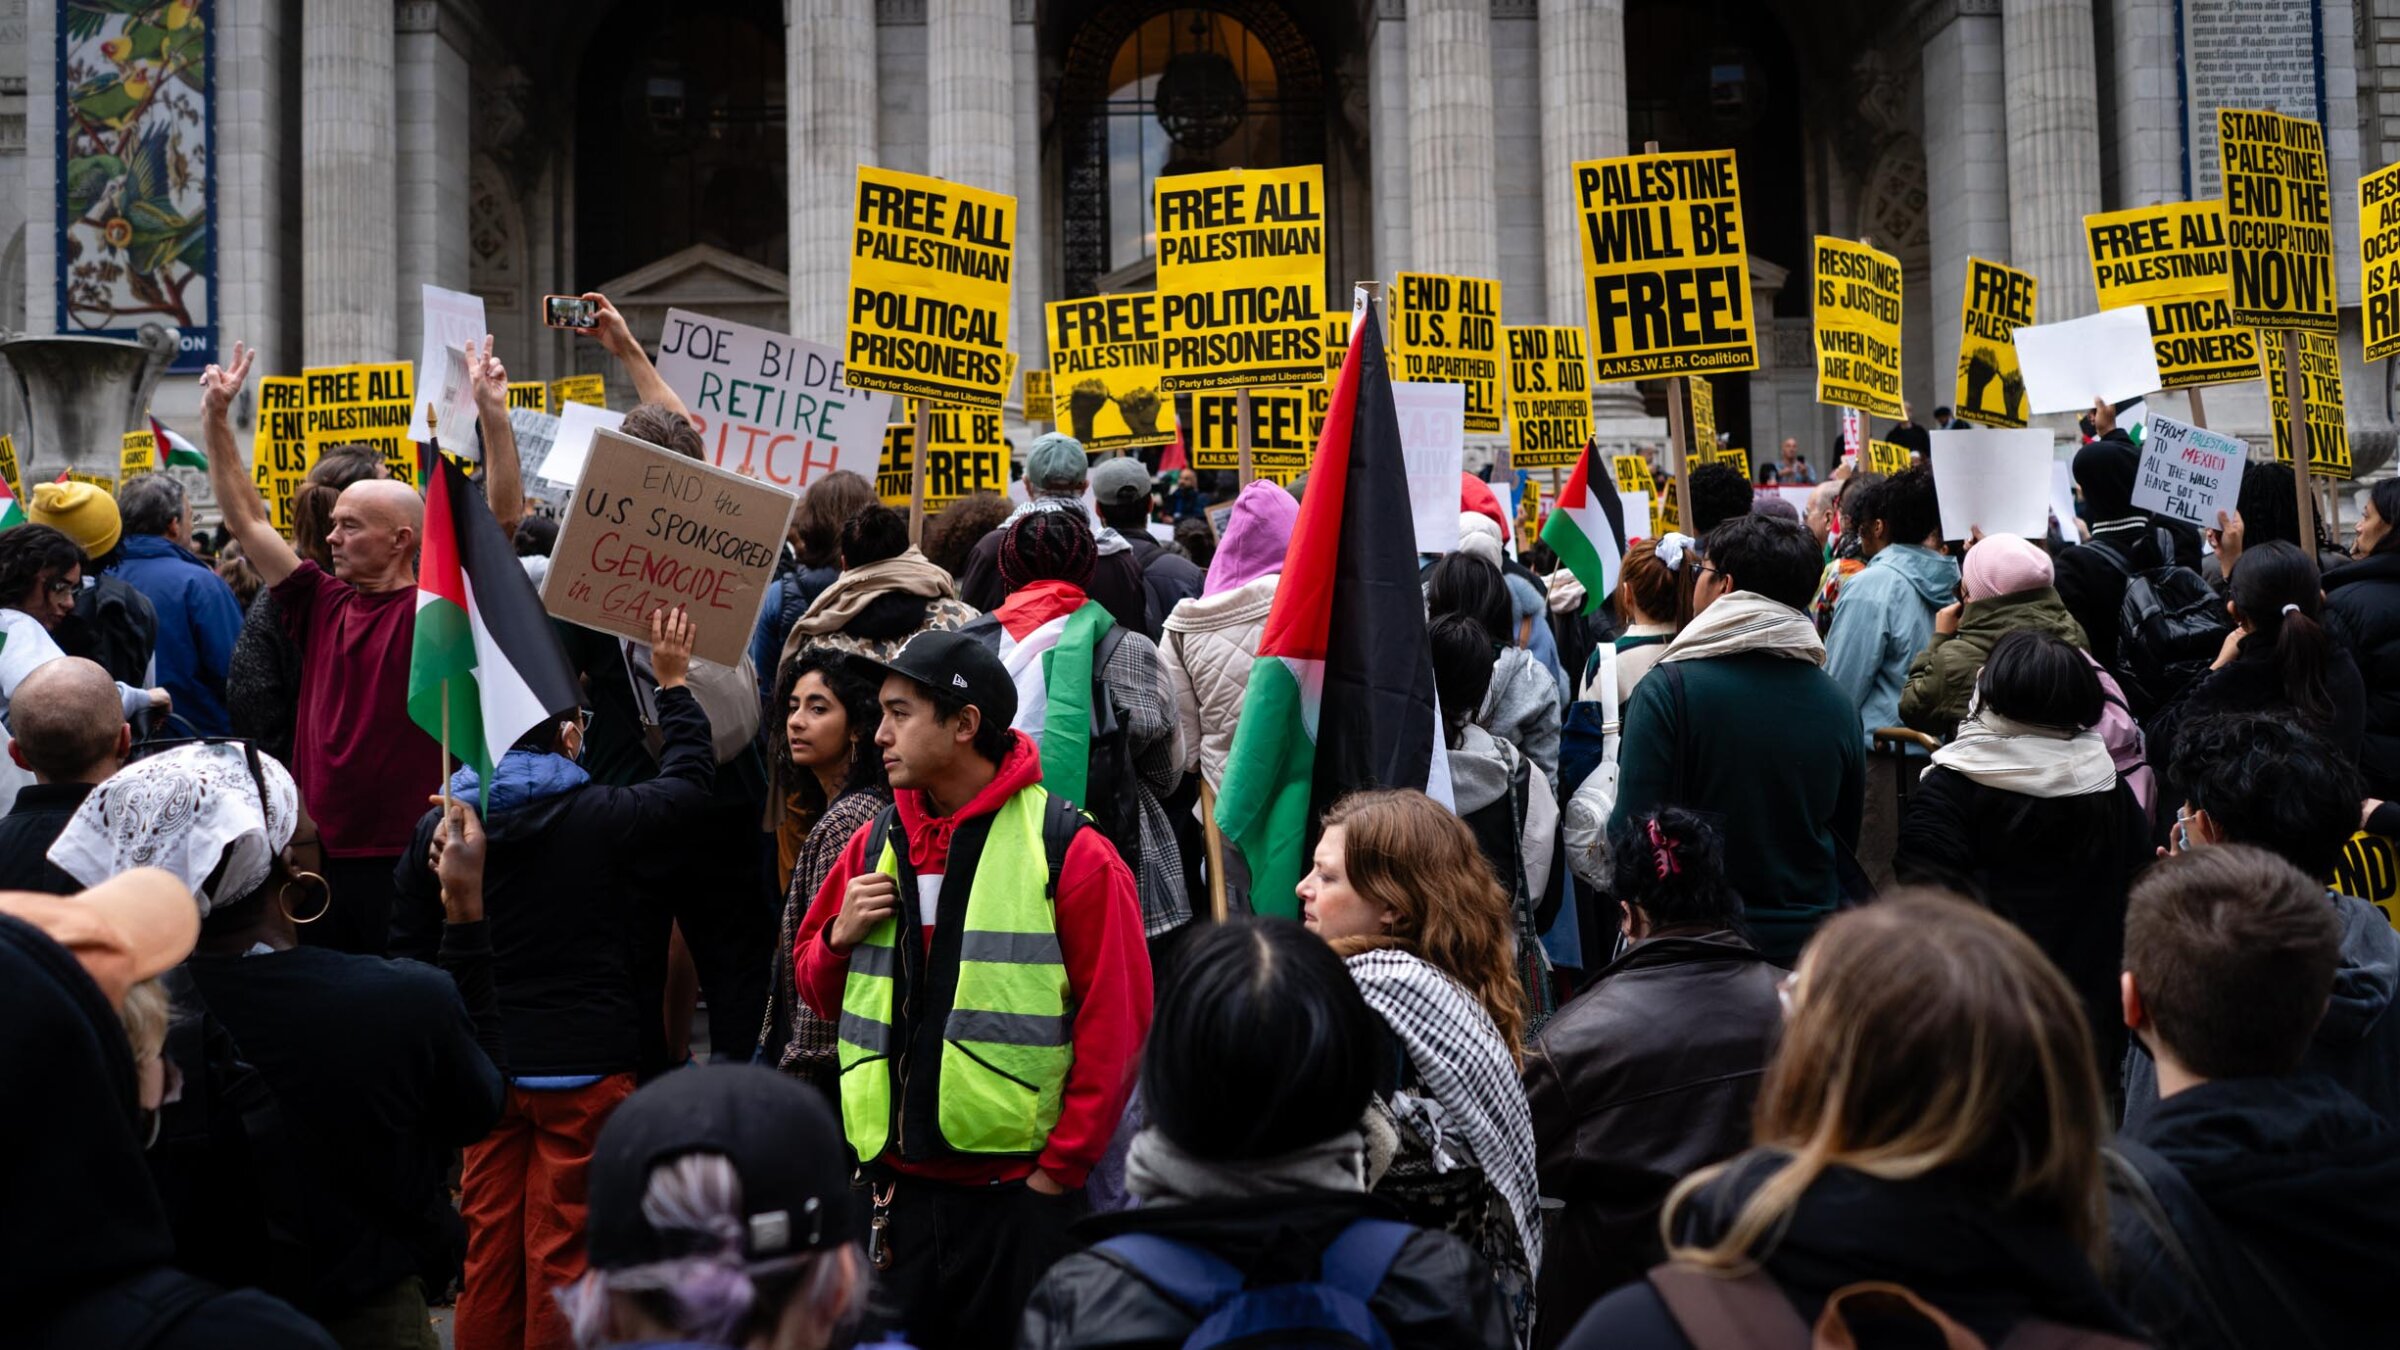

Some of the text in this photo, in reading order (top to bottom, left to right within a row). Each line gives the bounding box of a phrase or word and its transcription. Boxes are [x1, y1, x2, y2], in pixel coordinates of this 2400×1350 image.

[2222, 112, 2321, 151] STAND WITH
[2224, 142, 2325, 182] PALESTINE!
[1579, 157, 1736, 208] PALESTINE
[2228, 174, 2328, 223] END THE
[859, 181, 1010, 250] FREE ALL
[1160, 181, 1320, 232] FREE ALL
[1161, 226, 1321, 266] PALESTINIAN
[1586, 202, 1740, 264] WILL BE
[2090, 212, 2226, 260] FREE ALL
[2229, 220, 2330, 254] OCCUPATION
[856, 228, 1009, 284] PALESTINIAN
[1818, 248, 1899, 295] RESISTANCE
[1403, 276, 1496, 317] END ALL
[1818, 281, 1835, 306] IS
[1972, 262, 2033, 325] FREE
[2232, 250, 2332, 313] NOW!
[2368, 265, 2384, 294] IS
[853, 287, 1003, 348] POLITICAL
[1056, 296, 1158, 349] FREE
[1163, 285, 1320, 332] POLITICAL
[1594, 265, 1747, 354] FREE!
[1965, 309, 2024, 345] PALES
[2148, 299, 2232, 336] LITICA
[662, 319, 733, 365] JOE
[1163, 326, 1321, 369] PRISONERS
[1326, 322, 1349, 347] LL
[1405, 313, 1494, 351] U.S. AID
[1508, 329, 1583, 360] END ALL
[1820, 329, 1898, 369] WHEN PEOPLE
[2156, 332, 2254, 368] SONERS
[2264, 330, 2336, 357] STD WITH
[850, 331, 1001, 386] PRISONERS
[1404, 354, 1495, 379] TO APARTHEID
[1512, 362, 1585, 392] U.S. AID
[1602, 352, 1750, 376] A.N.S.W.E.R. Coalition
[1824, 356, 1899, 396] ARE OCCUPIED!
[2168, 368, 2260, 385] Socialism and Liberation
[2267, 350, 2339, 377] PASTINE!
[307, 370, 410, 405] FREE ALL
[864, 377, 1001, 407] Party for Socialism and Liberation
[1179, 370, 1322, 390] Party for Socialism and Liberation
[2313, 374, 2343, 405] THE
[308, 405, 411, 432] PALESTINIAN
[698, 371, 845, 442] RETIRE
[1200, 396, 1303, 449] FREE!
[1514, 399, 1588, 418] TO APARTHEID
[2273, 401, 2344, 426] OCPATION
[972, 414, 1000, 445] BE
[1519, 420, 1588, 450] ISRAEL!
[2154, 418, 2237, 455] FROM PALESTINE
[1260, 455, 1304, 464] Coalition
[2155, 436, 2226, 471] TO MEXICO
[275, 479, 290, 495] TO
[643, 464, 743, 517] END the
[925, 450, 1002, 496] REE!
[2144, 455, 2219, 490] ALL THE WALLS
[2144, 474, 2214, 506] HAVE GOT TO
[2165, 496, 2203, 522] FALL
[646, 508, 774, 569] SPONSORED
[568, 573, 591, 603] in
[591, 532, 738, 611] GENOCIDE
[2330, 836, 2397, 903] ND
